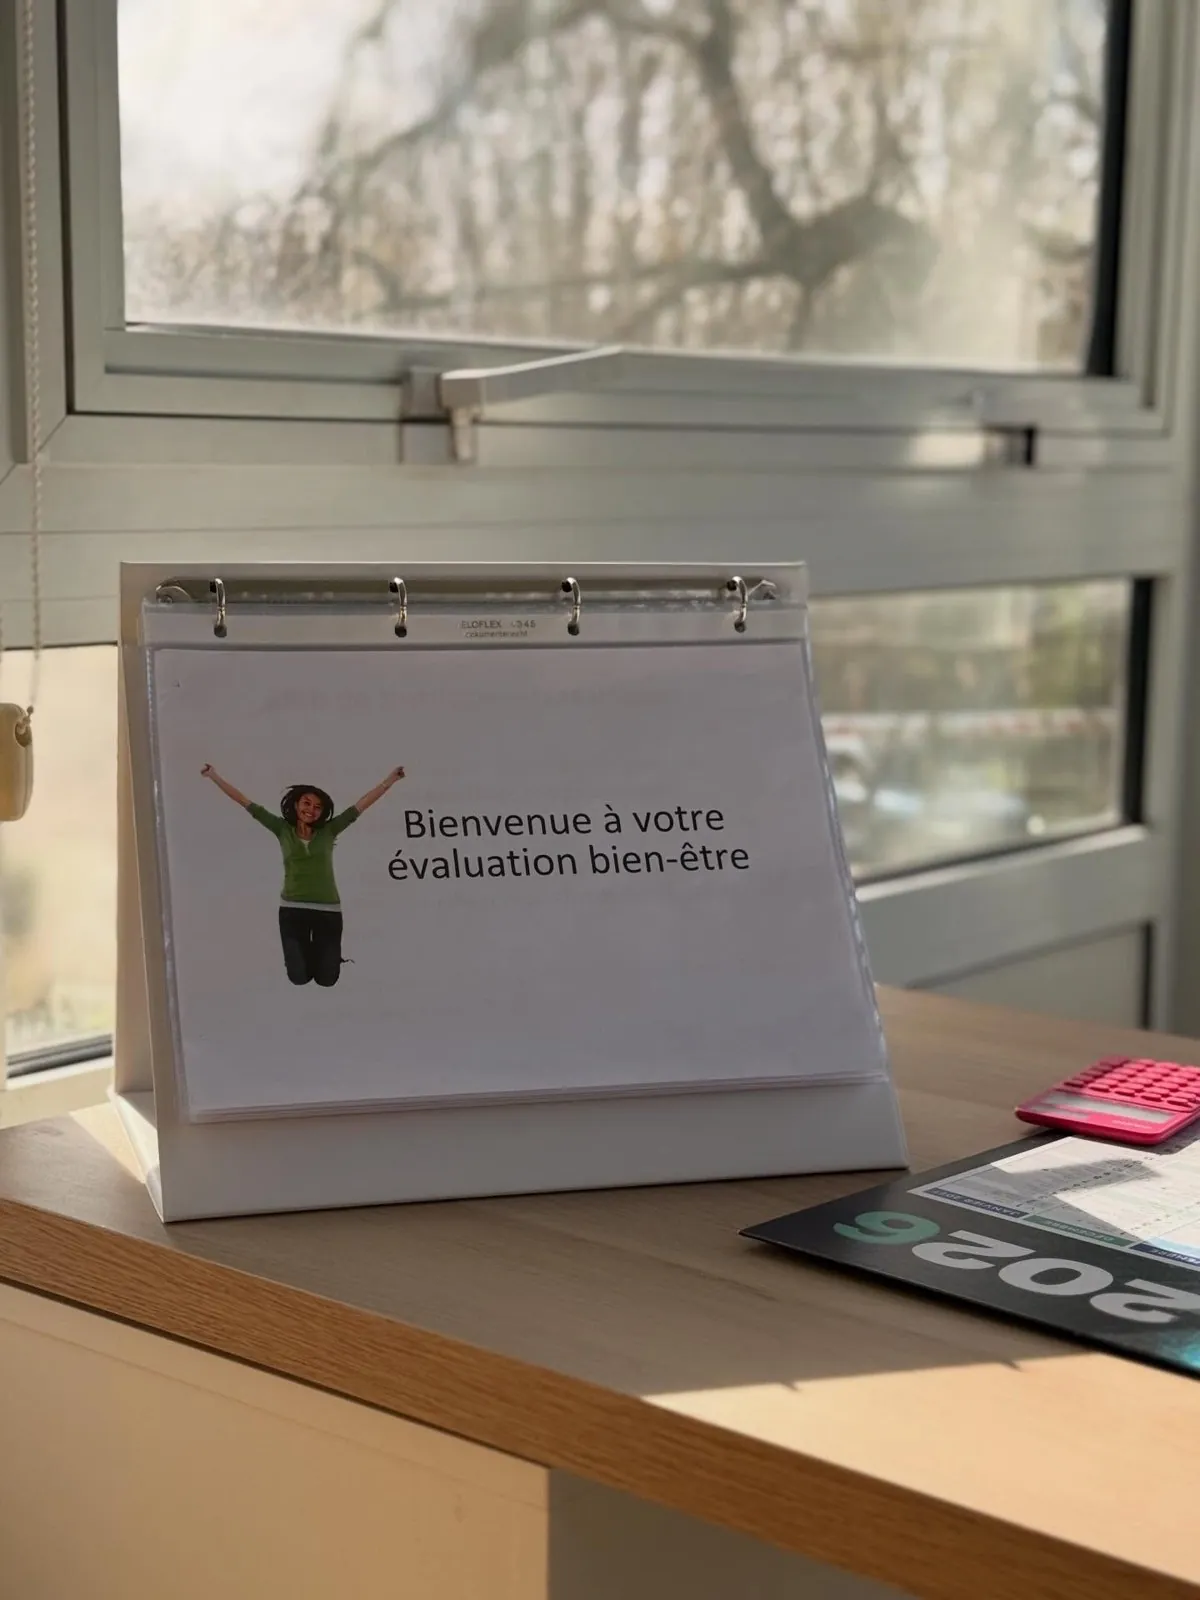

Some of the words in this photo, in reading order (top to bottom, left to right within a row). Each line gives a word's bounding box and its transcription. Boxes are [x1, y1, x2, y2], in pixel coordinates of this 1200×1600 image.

[405, 808, 591, 839] Bienvenue
[603, 803, 622, 834] à
[631, 805, 725, 833] votre
[387, 847, 578, 881] évaluation
[588, 842, 750, 874] bien-être
[833, 1210, 1200, 1323] 2026
